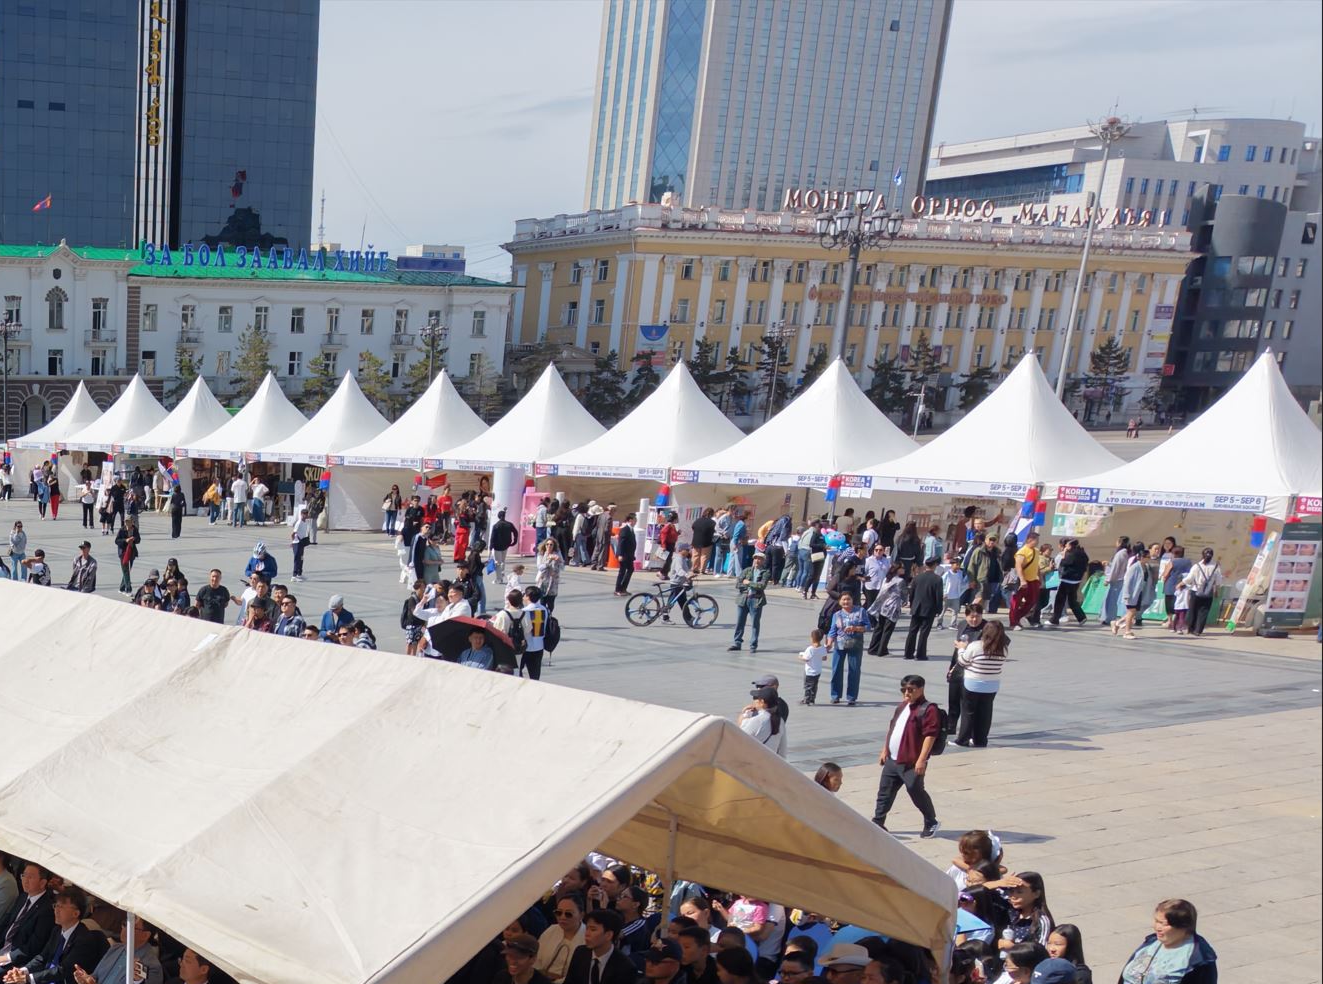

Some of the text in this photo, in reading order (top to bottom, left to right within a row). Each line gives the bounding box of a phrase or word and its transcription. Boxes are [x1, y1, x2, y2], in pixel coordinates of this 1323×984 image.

[783, 188, 886, 213] МОНГЛ
[911, 196, 995, 218] ОРНОО
[144, 242, 389, 272] ЗА БОЛ ЗААВАЛ ХИЙЕ
